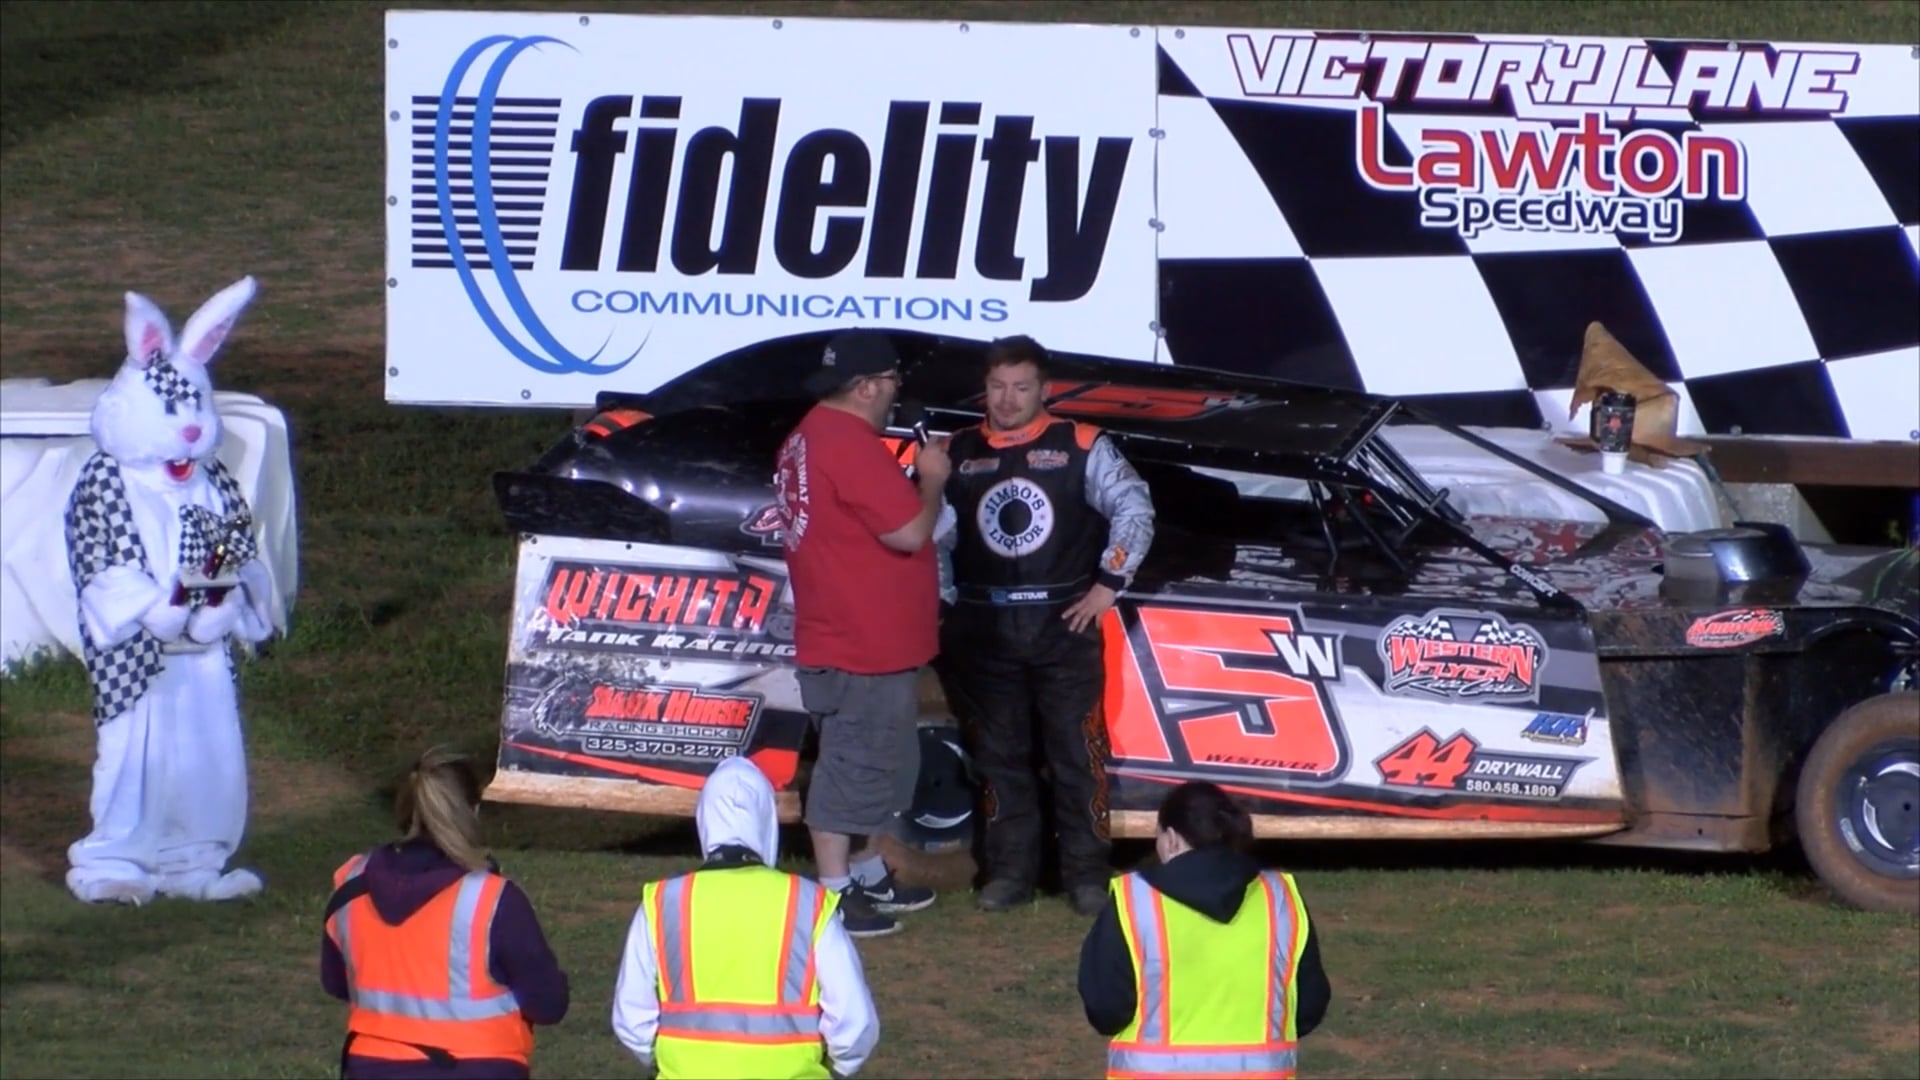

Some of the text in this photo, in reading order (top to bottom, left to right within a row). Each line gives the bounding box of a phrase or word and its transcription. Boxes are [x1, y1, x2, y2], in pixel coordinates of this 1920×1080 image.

[1227, 34, 1860, 117] VICTORY LANE
[1362, 106, 1740, 197] Lawton
[560, 95, 1133, 302] fidelity
[1423, 187, 1680, 239] Speedway
[571, 289, 1009, 321] COMMUNICATIONS
[985, 485, 1045, 515] JIMBO'S
[989, 525, 1044, 550] LIQUOR
[546, 568, 777, 632] WICHITA
[1390, 635, 1535, 685] WESTERN
[1412, 662, 1512, 683] FLYER
[661, 690, 753, 727] HORSE
[589, 721, 740, 740] RACING SHOCKS
[1206, 754, 1319, 771] WESTOVER
[1379, 731, 1563, 788] 44 DRYWALL
